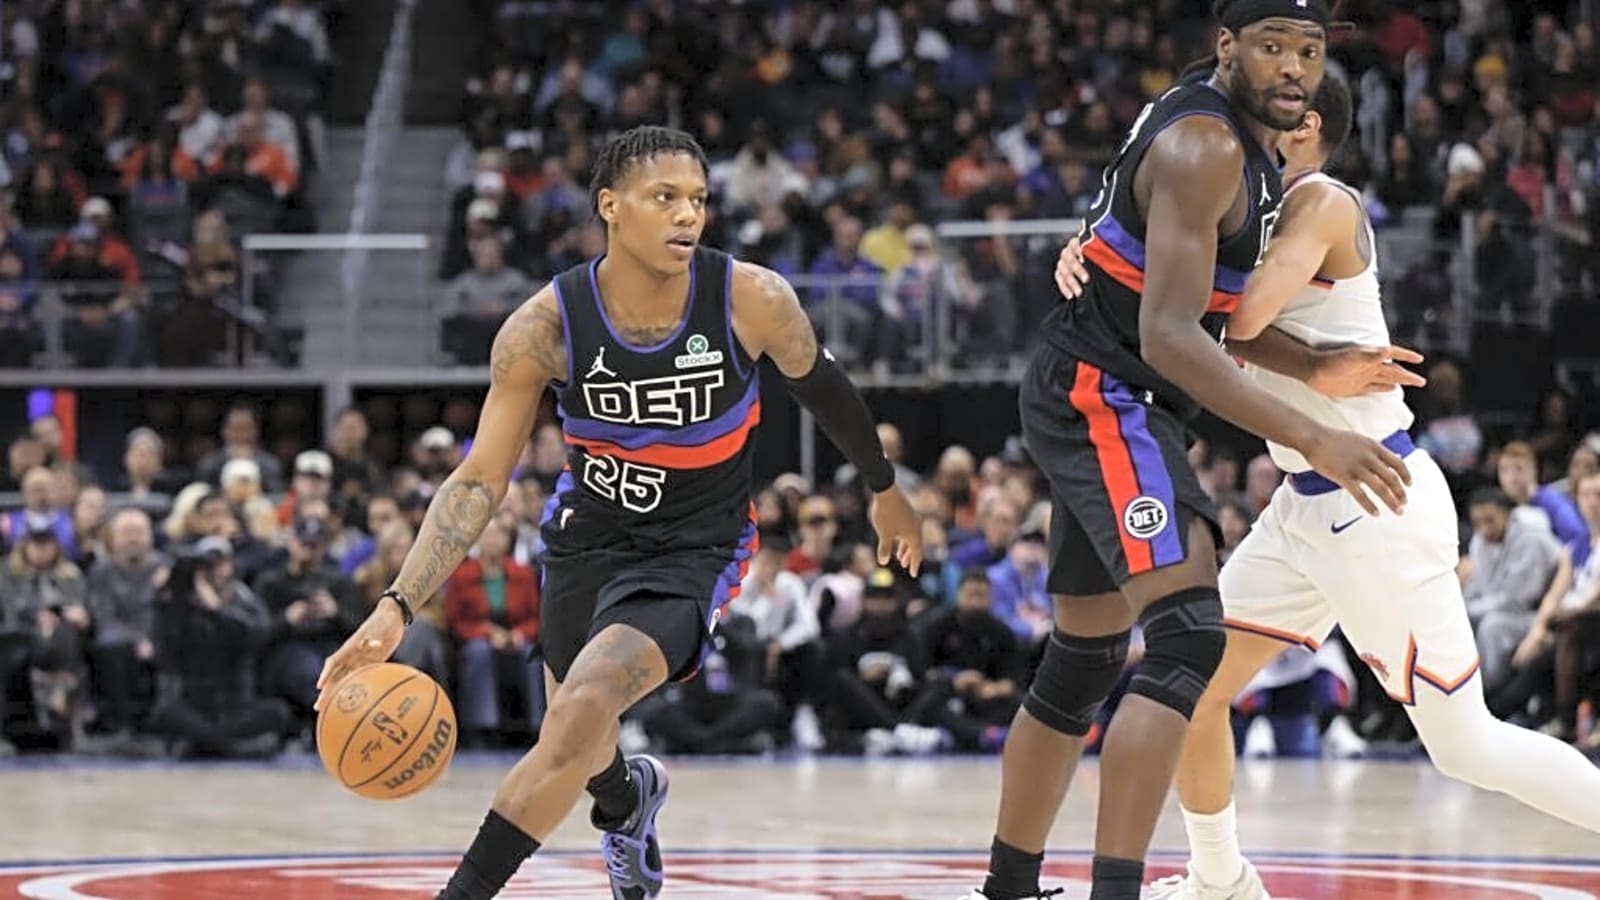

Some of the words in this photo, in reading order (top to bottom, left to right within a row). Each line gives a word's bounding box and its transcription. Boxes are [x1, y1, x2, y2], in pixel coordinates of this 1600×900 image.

[677, 353, 721, 367] StockX
[582, 369, 724, 426] DET
[583, 454, 667, 513] 25
[1131, 508, 1161, 527] DET
